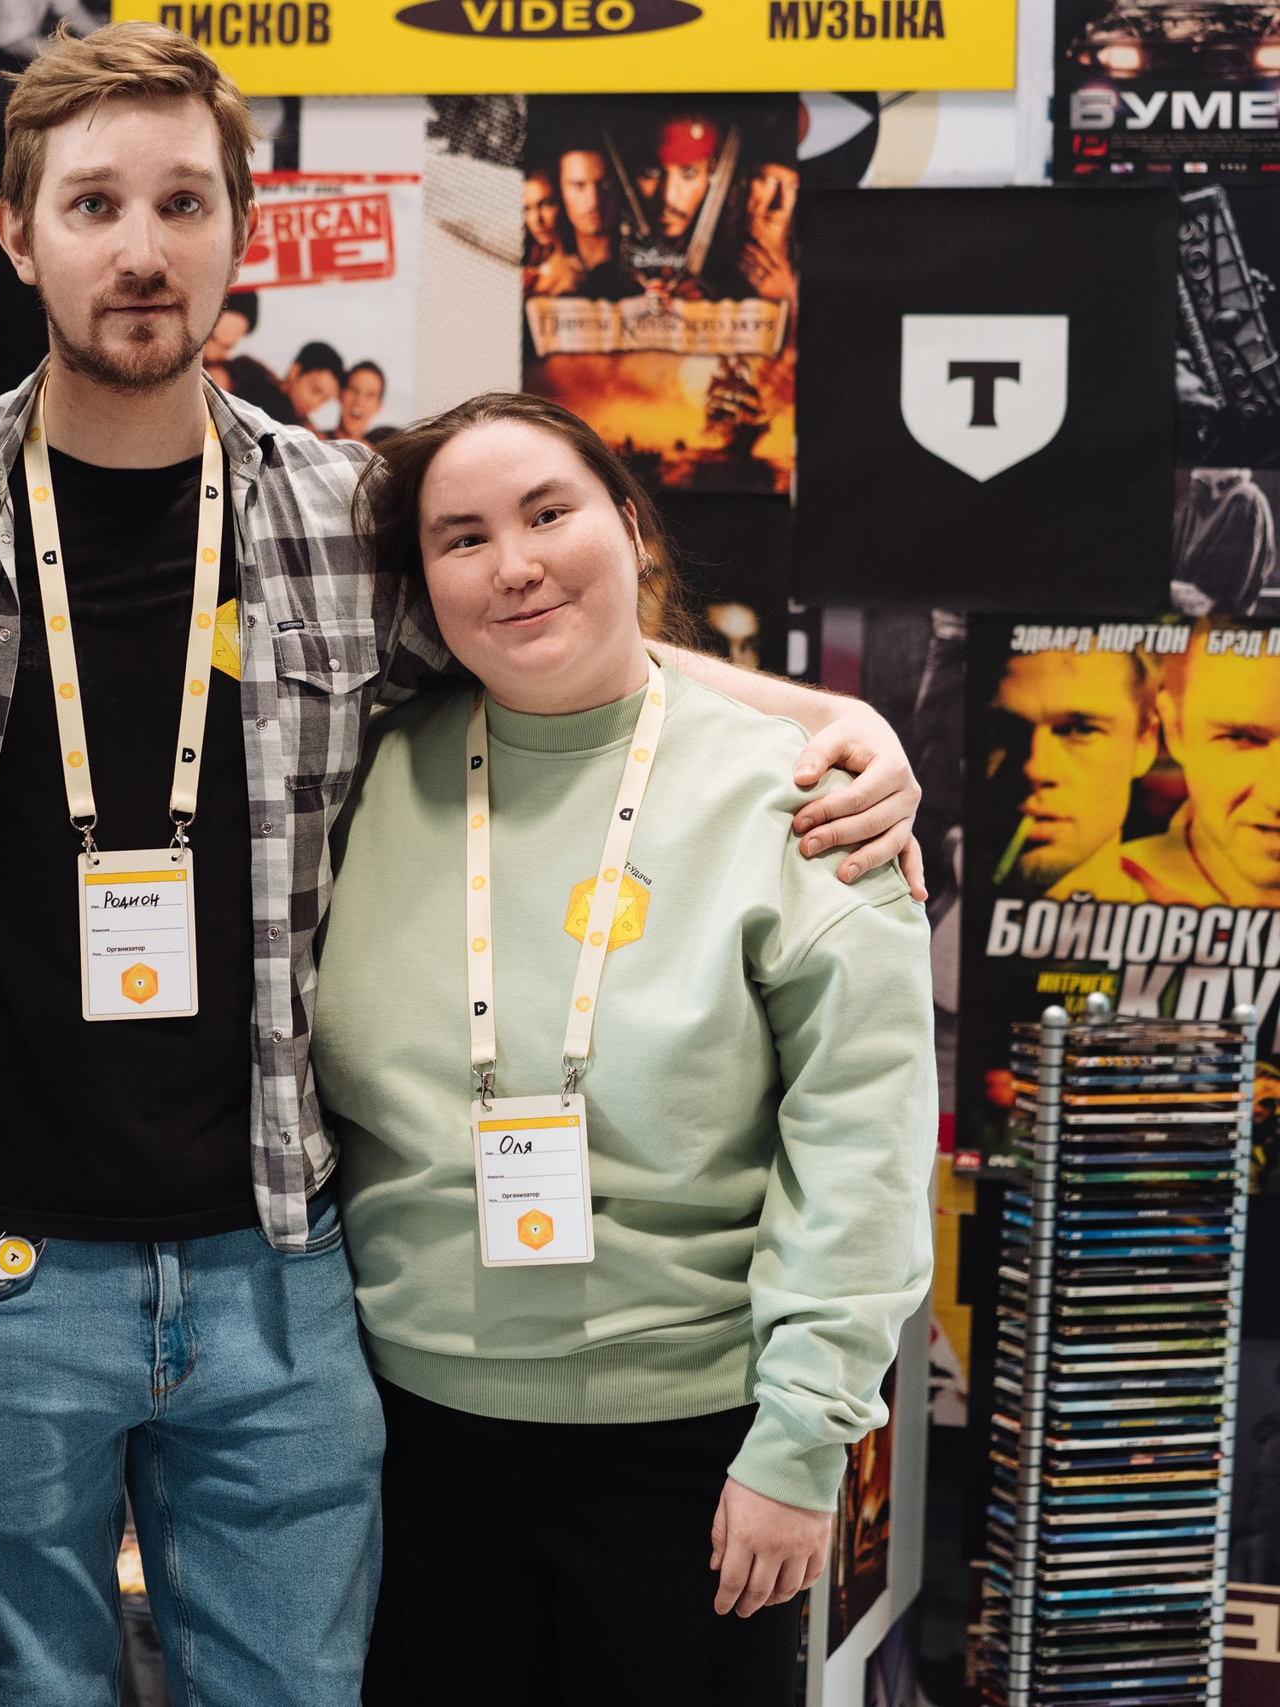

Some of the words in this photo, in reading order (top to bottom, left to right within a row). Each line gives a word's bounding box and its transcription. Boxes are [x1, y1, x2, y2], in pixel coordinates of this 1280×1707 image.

[461, 0, 635, 33] VIDEO
[767, 0, 945, 40] МУЗЫКА
[1011, 625, 1094, 654] ЭДВАРД
[1096, 623, 1191, 654] НОРТОН
[1206, 630, 1263, 658] БРЭД
[624, 861, 653, 886] Т-Удача
[103, 890, 161, 909] Родион
[499, 1135, 532, 1155] Оля
[501, 1191, 540, 1200] Организатор
